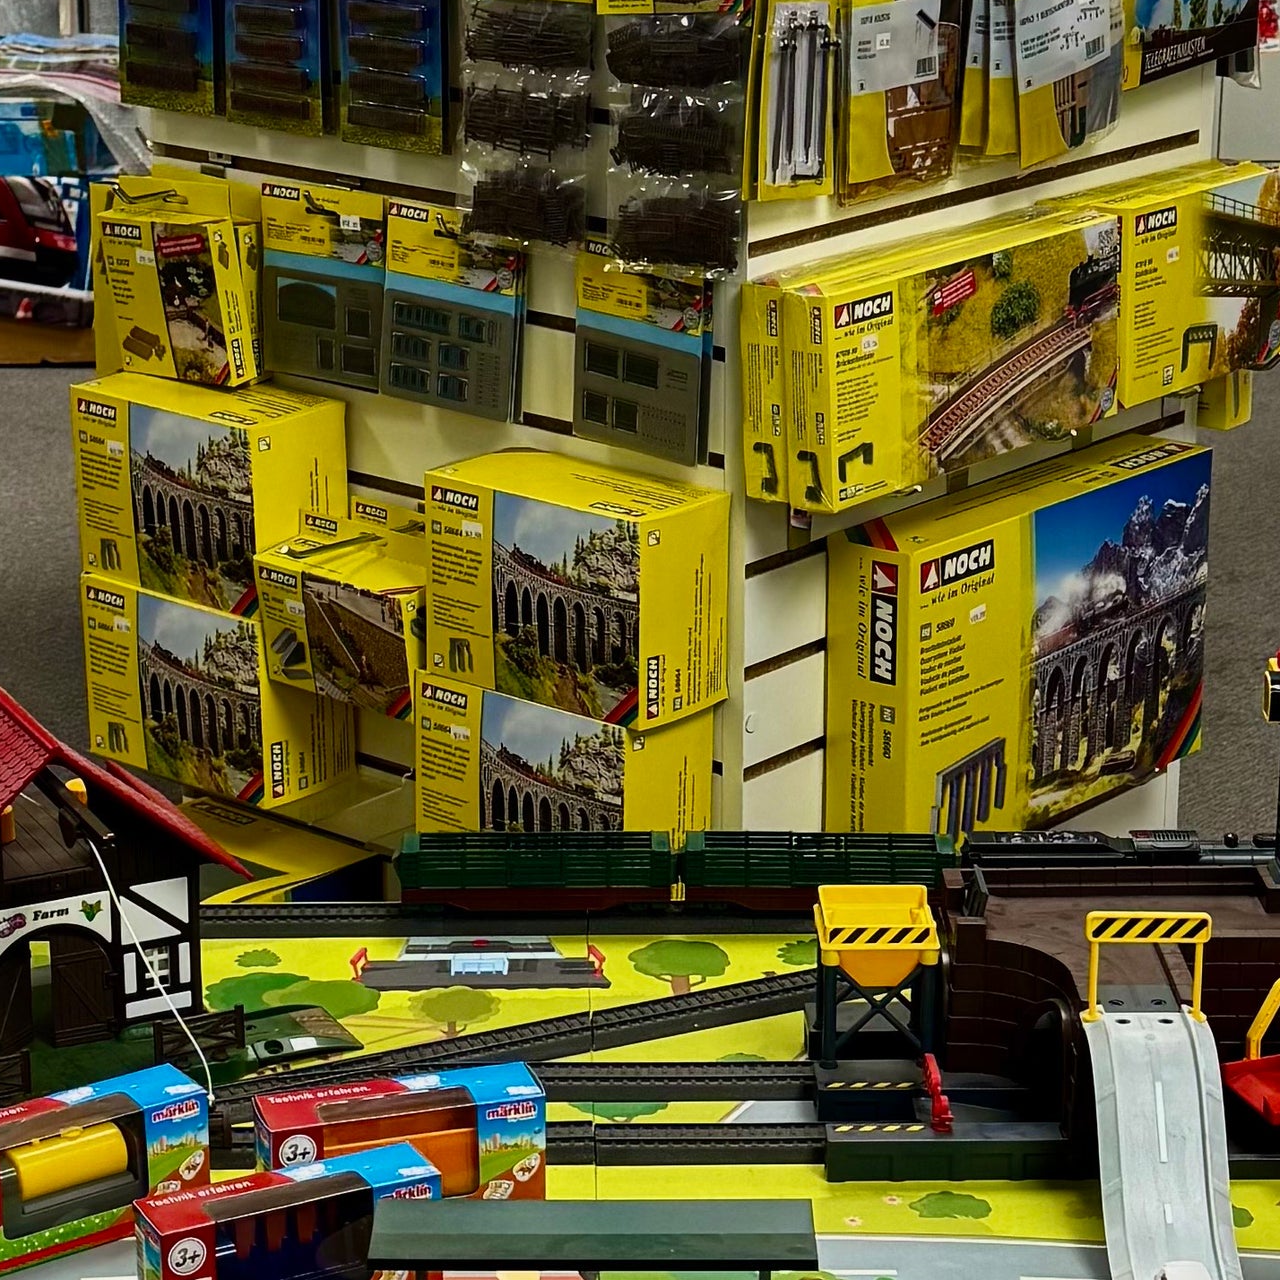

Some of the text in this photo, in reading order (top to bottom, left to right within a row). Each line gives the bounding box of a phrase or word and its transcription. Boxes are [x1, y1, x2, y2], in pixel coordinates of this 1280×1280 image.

[273, 186, 299, 199] NOCH
[400, 208, 428, 220] NOCH
[1148, 210, 1177, 227] NOCH
[114, 225, 139, 238] NOCH
[855, 294, 892, 317] NOCH
[867, 316, 894, 334] Original
[89, 403, 116, 418] NOCH
[446, 490, 477, 508] NOCH
[944, 547, 991, 578] NOCH
[271, 571, 296, 587] NOCH
[98, 592, 124, 606] NOCH
[932, 574, 994, 606] wie im Original
[859, 602, 866, 616] im
[874, 599, 893, 680] NOCH
[857, 622, 868, 679] Original
[649, 659, 658, 698] NOCH
[436, 691, 467, 708] NOCH
[273, 745, 282, 785] NOCH
[266, 1084, 371, 1105] Technik erfahren.
[285, 1143, 311, 1163] 3+
[146, 1178, 255, 1208] Technik erfahren.
[174, 1246, 201, 1267] 3+
